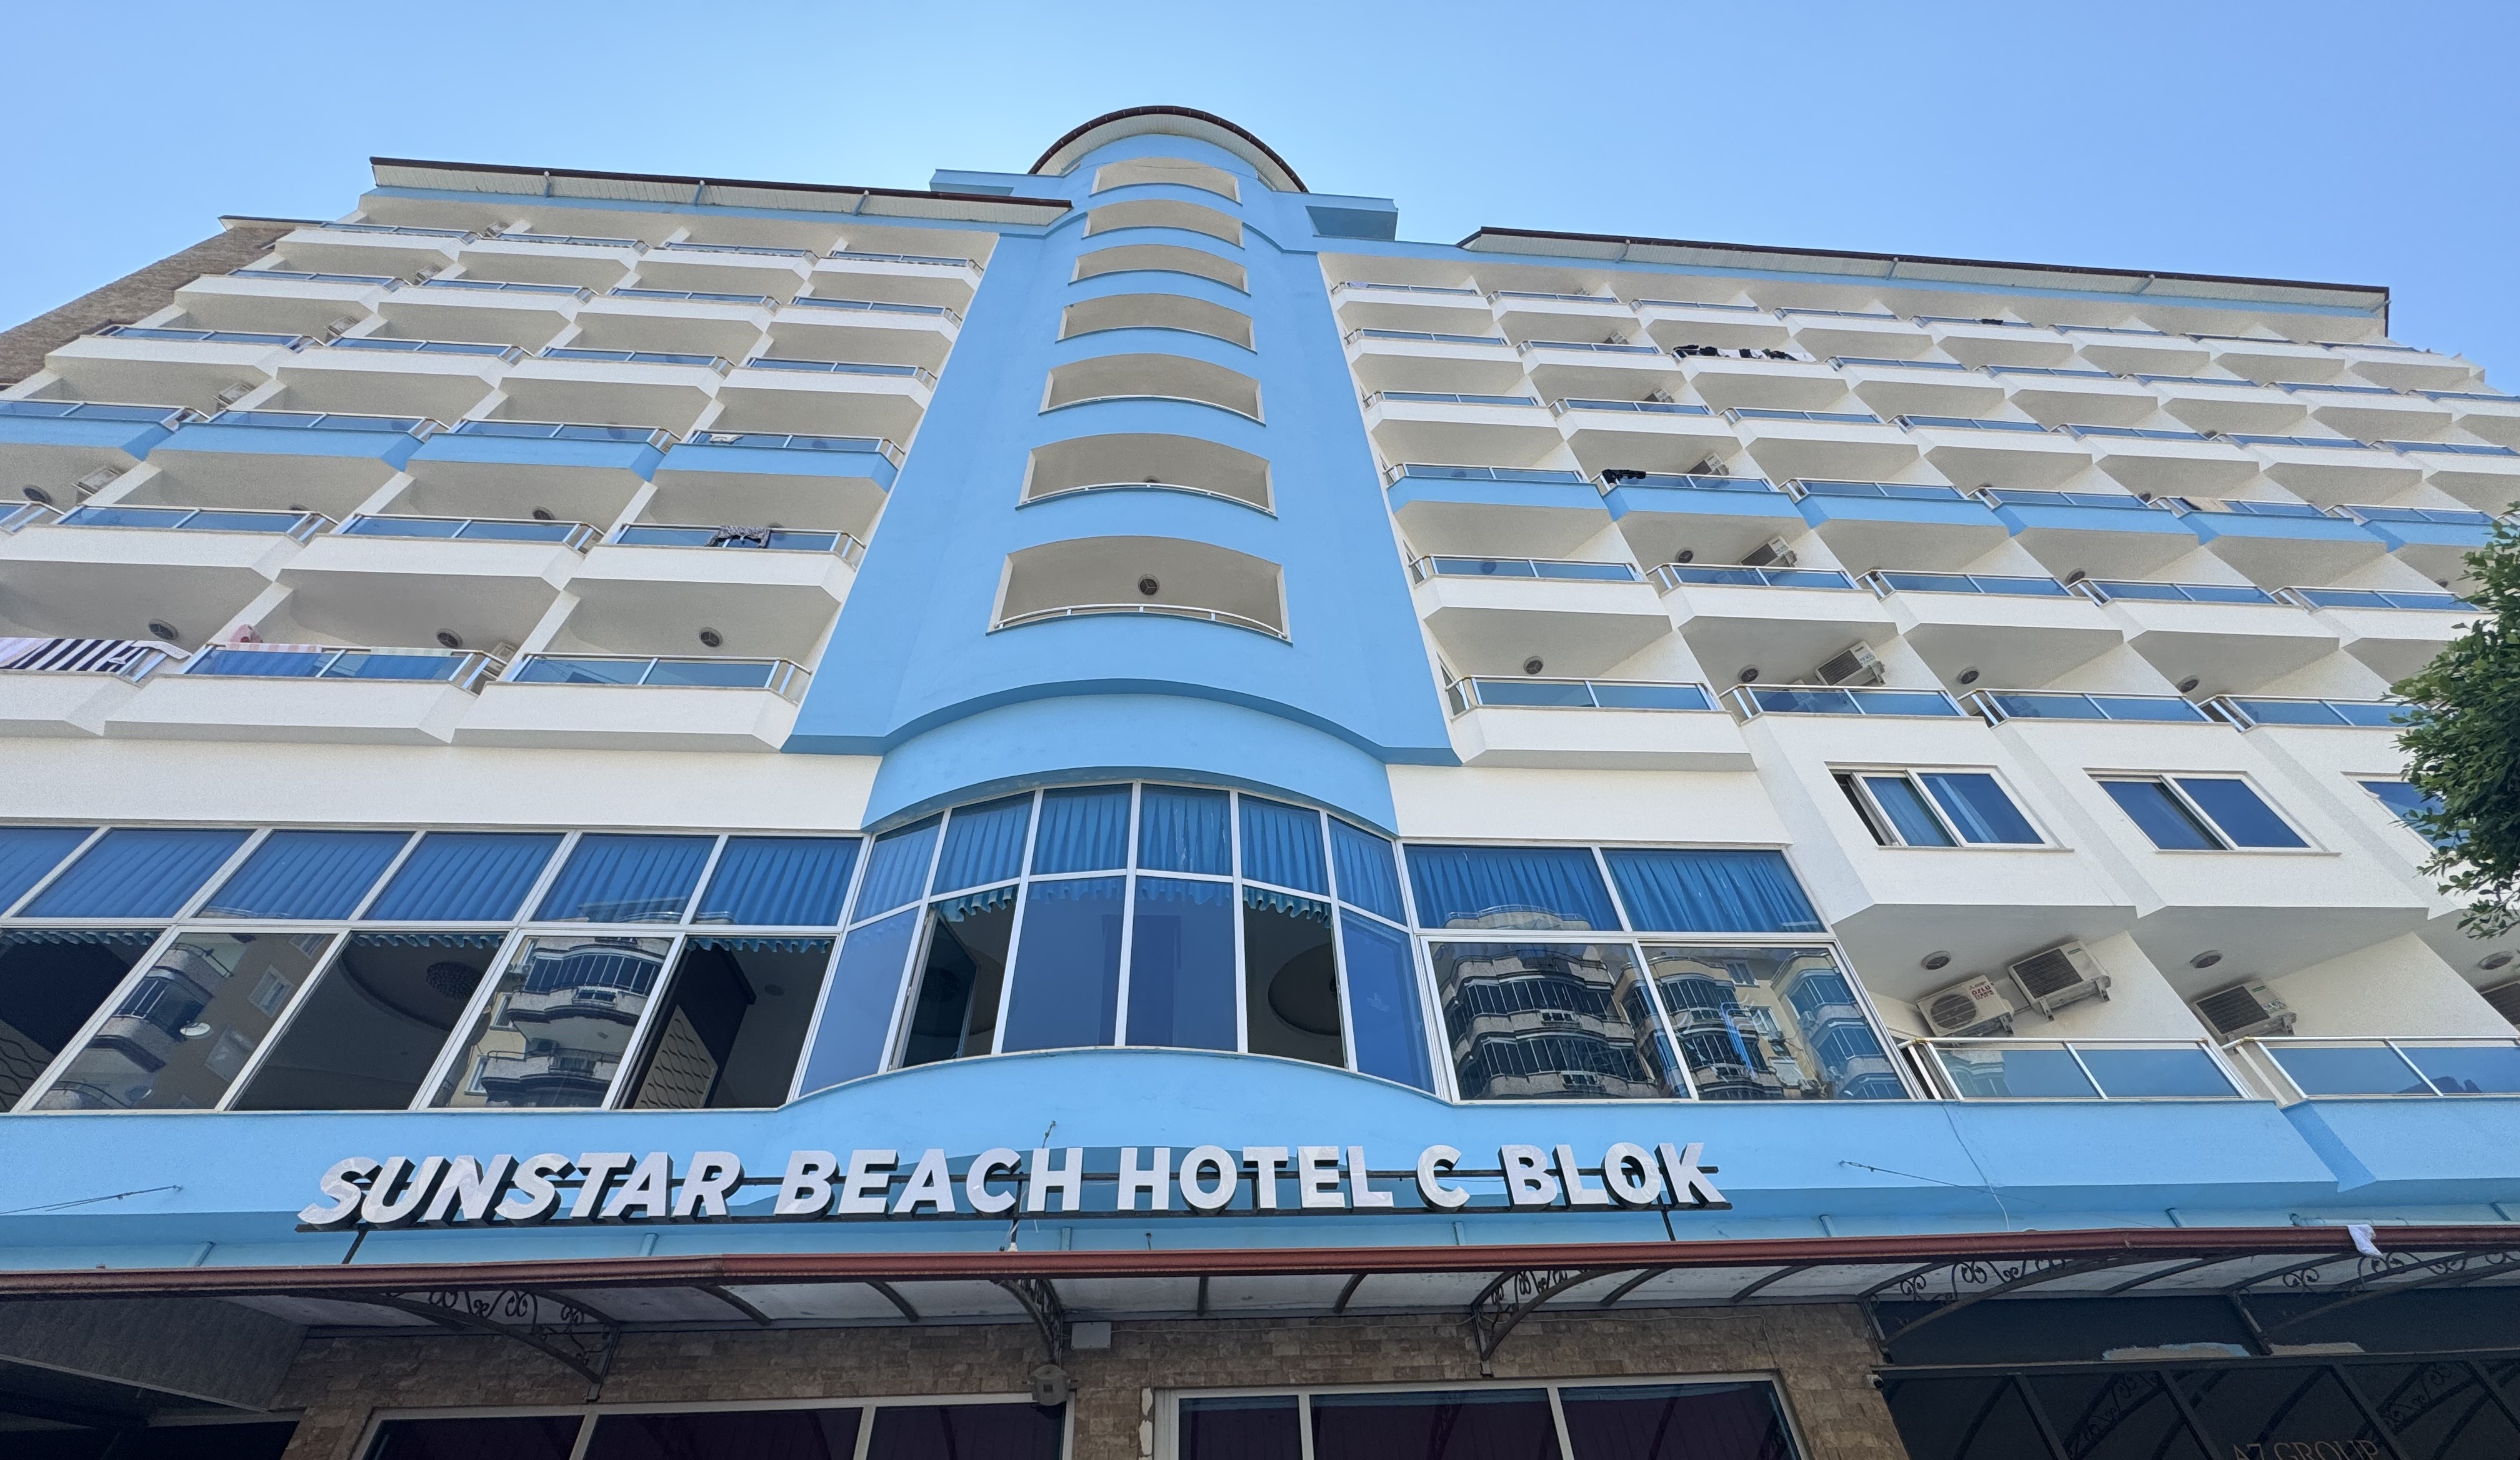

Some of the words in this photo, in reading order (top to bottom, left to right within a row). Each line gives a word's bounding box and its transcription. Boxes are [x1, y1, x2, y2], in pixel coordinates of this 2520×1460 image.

[297, 1150, 744, 1225] SUNSTAR
[773, 1146, 1083, 1217] BEACH
[1117, 1144, 1394, 1212] HOTEL
[1416, 1144, 1471, 1210] C
[1499, 1141, 1726, 1208] BLOK
[2274, 1439, 2378, 1460] GROUP
